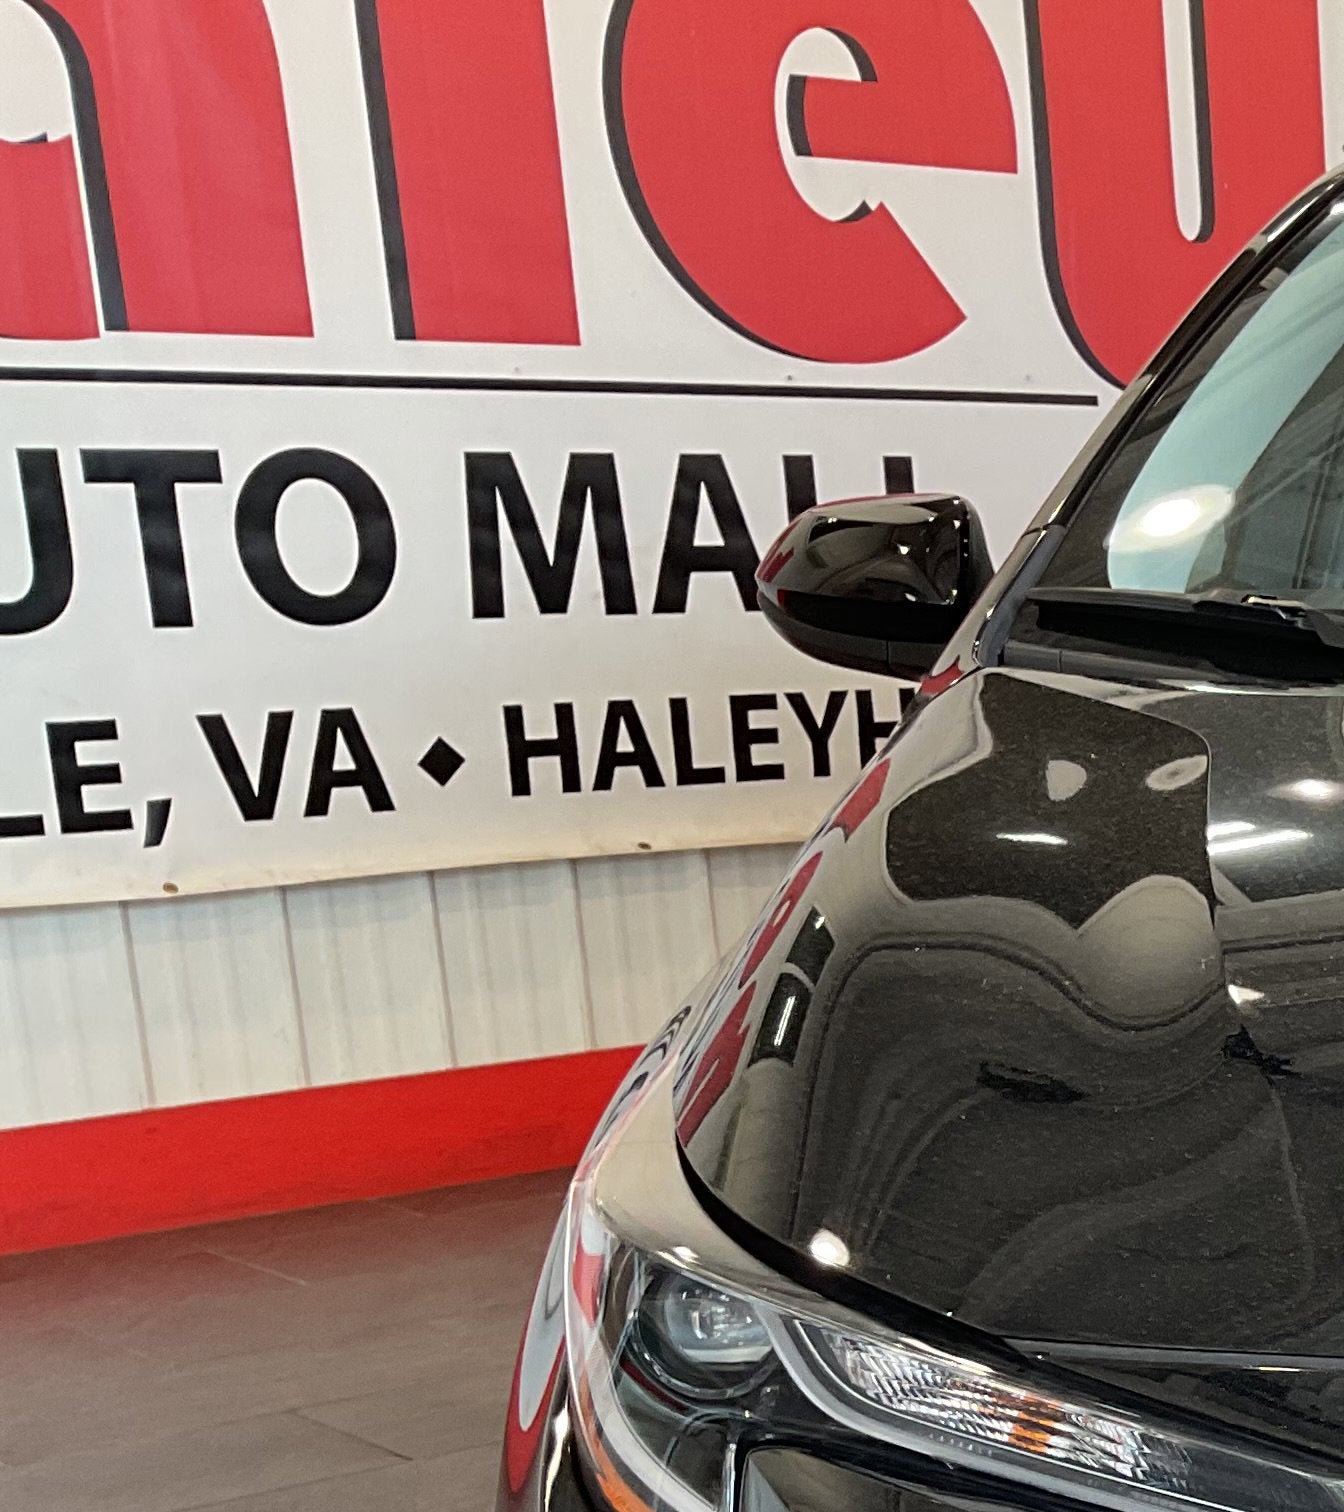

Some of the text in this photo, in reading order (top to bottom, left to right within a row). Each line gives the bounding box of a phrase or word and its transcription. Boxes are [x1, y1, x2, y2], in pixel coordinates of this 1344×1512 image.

[465, 451, 916, 620] MA
[0, 719, 172, 848] E,
[196, 708, 396, 821] VA
